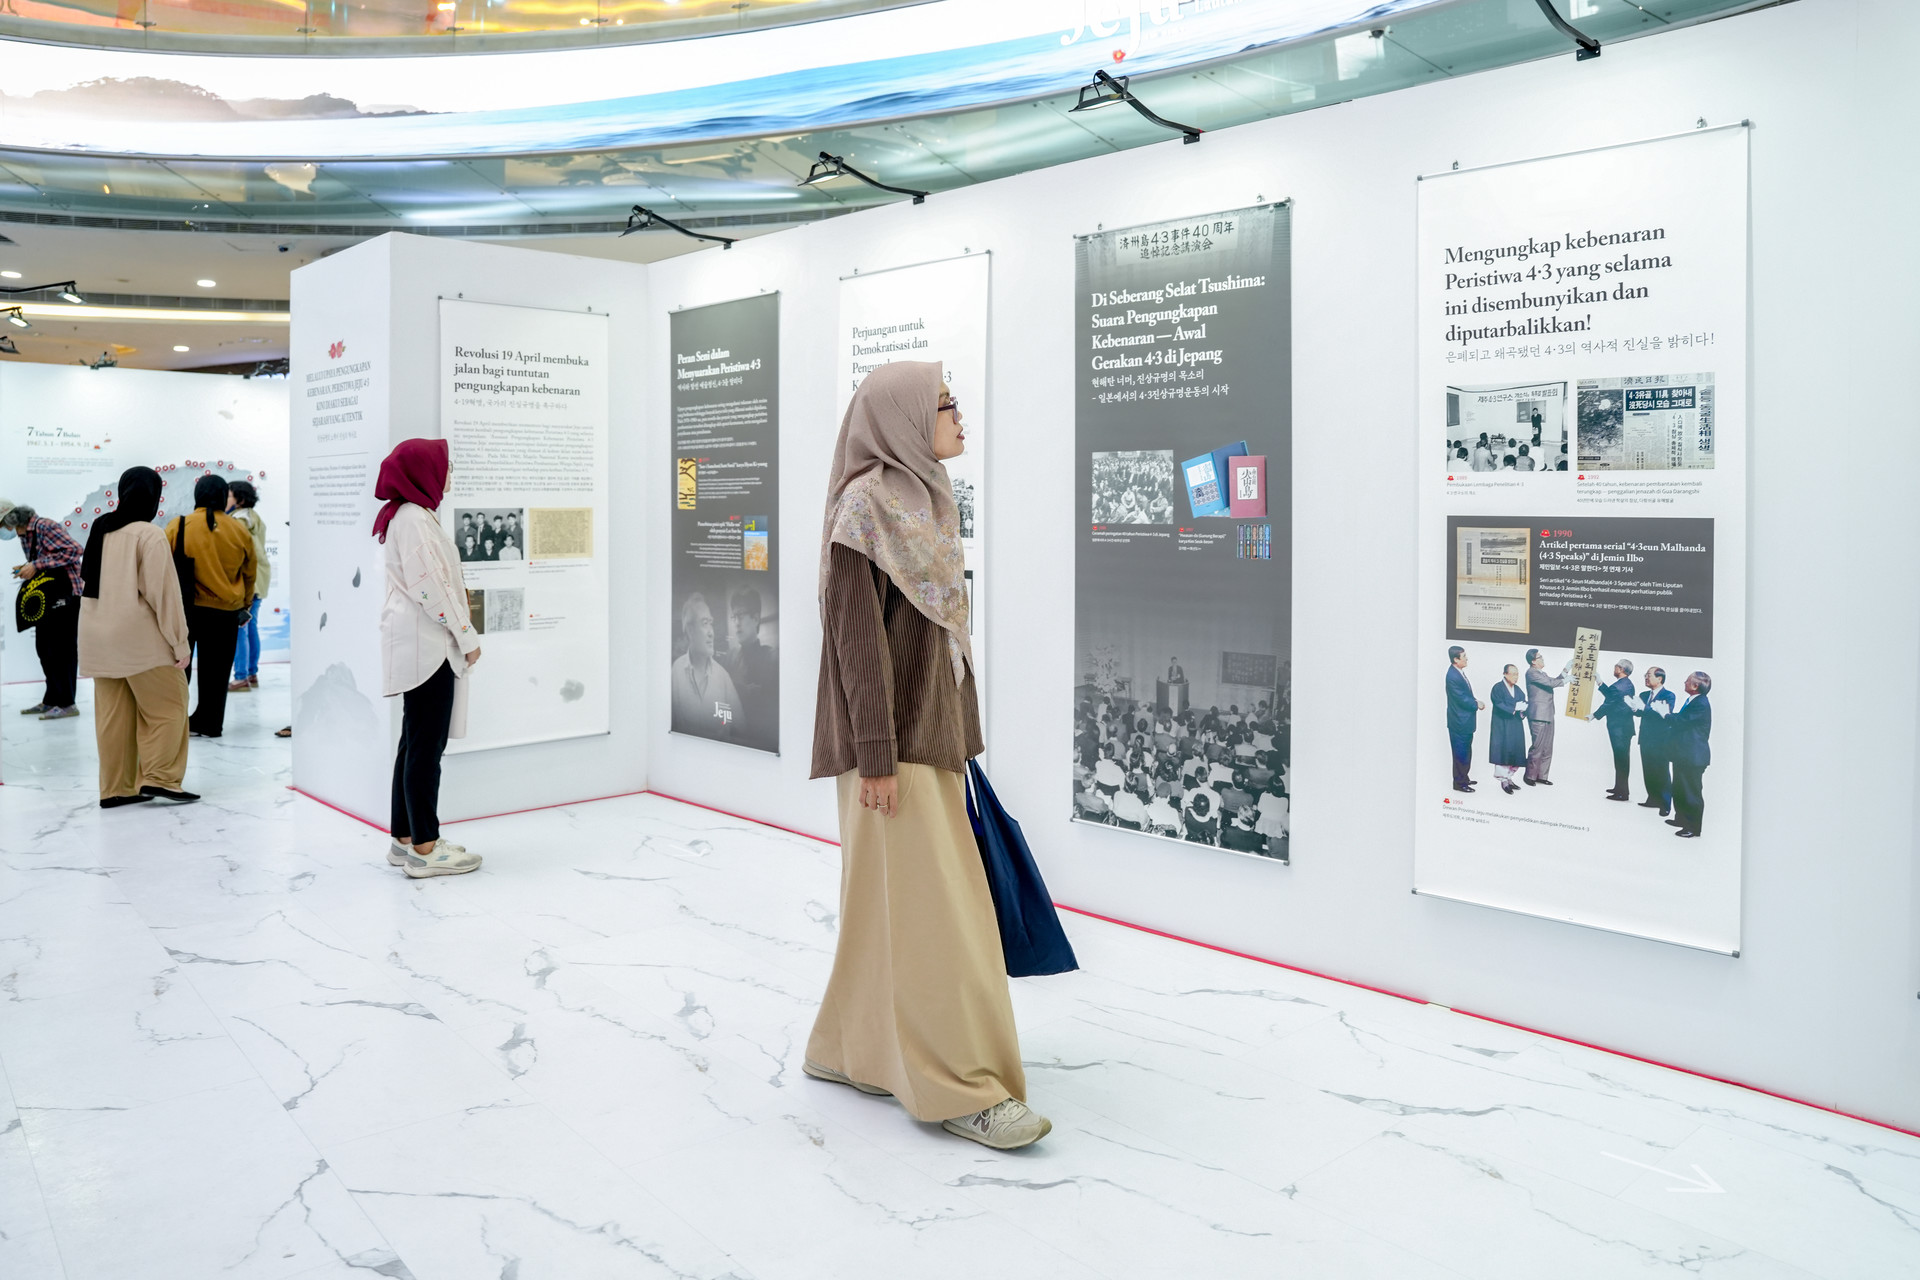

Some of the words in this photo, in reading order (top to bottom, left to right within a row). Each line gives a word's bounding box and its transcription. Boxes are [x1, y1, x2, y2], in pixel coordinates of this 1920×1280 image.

[1444, 237, 1561, 265] Mengungkap
[1565, 225, 1665, 250] kebenaran
[1445, 268, 1522, 290] Peristiwa
[1556, 262, 1601, 284] yang
[1604, 252, 1672, 274] selama
[1092, 293, 1107, 307] Di
[1109, 289, 1164, 305] Seberang
[1166, 280, 1196, 298] Selat
[1198, 275, 1265, 293] Tsushima:
[1445, 300, 1467, 315] ini
[1471, 287, 1608, 313] disembunyikan
[1613, 283, 1649, 300] dan
[1092, 314, 1124, 328] Suara
[1127, 304, 1217, 326] Pengungkapan
[852, 325, 897, 340] Perjuangan
[899, 318, 925, 332] untuk
[1092, 333, 1154, 349] Kebenaran
[1173, 324, 1206, 341] Awal
[1445, 314, 1591, 345] diputarbalikkan!
[455, 346, 498, 359] Revolusi
[502, 351, 513, 360] 19
[515, 351, 540, 365] April
[543, 355, 589, 366] membuka
[678, 354, 695, 364] Peran
[696, 351, 710, 362] Seni
[711, 348, 729, 359] dalam
[853, 339, 910, 356] Demokratisasi
[912, 337, 928, 348] dan
[1446, 348, 1491, 363] 은폐되고
[1581, 339, 1618, 354] 역사적
[1623, 336, 1663, 351] 진실을
[1668, 333, 1714, 348] 밝히다!
[1092, 353, 1142, 370] Gerakan
[1165, 349, 1177, 364] di
[1178, 349, 1222, 367] Jepang
[454, 363, 480, 376] jalan
[483, 365, 504, 378] bagi
[507, 367, 549, 378] tuntutan
[677, 365, 719, 381] Menyuarakan
[720, 362, 749, 374] Peristiwa
[1092, 377, 1114, 387] 현해탄
[1117, 375, 1135, 386] 너머,
[1137, 372, 1176, 384] 진상규명의
[1179, 369, 1204, 381] 목소리
[454, 381, 529, 395] pengungkapan
[532, 383, 580, 396] kebenaran
[27, 426, 34, 436] 7
[57, 428, 63, 437] 7
[1553, 530, 1572, 538] 1990
[1540, 541, 1568, 549] Artikel
[1570, 542, 1601, 551] pertama
[1603, 542, 1625, 550] serial
[1661, 543, 1705, 552] Malhanda
[1591, 553, 1599, 561] di
[1600, 554, 1624, 562] Jemin
[1627, 554, 1643, 562] Ilbo
